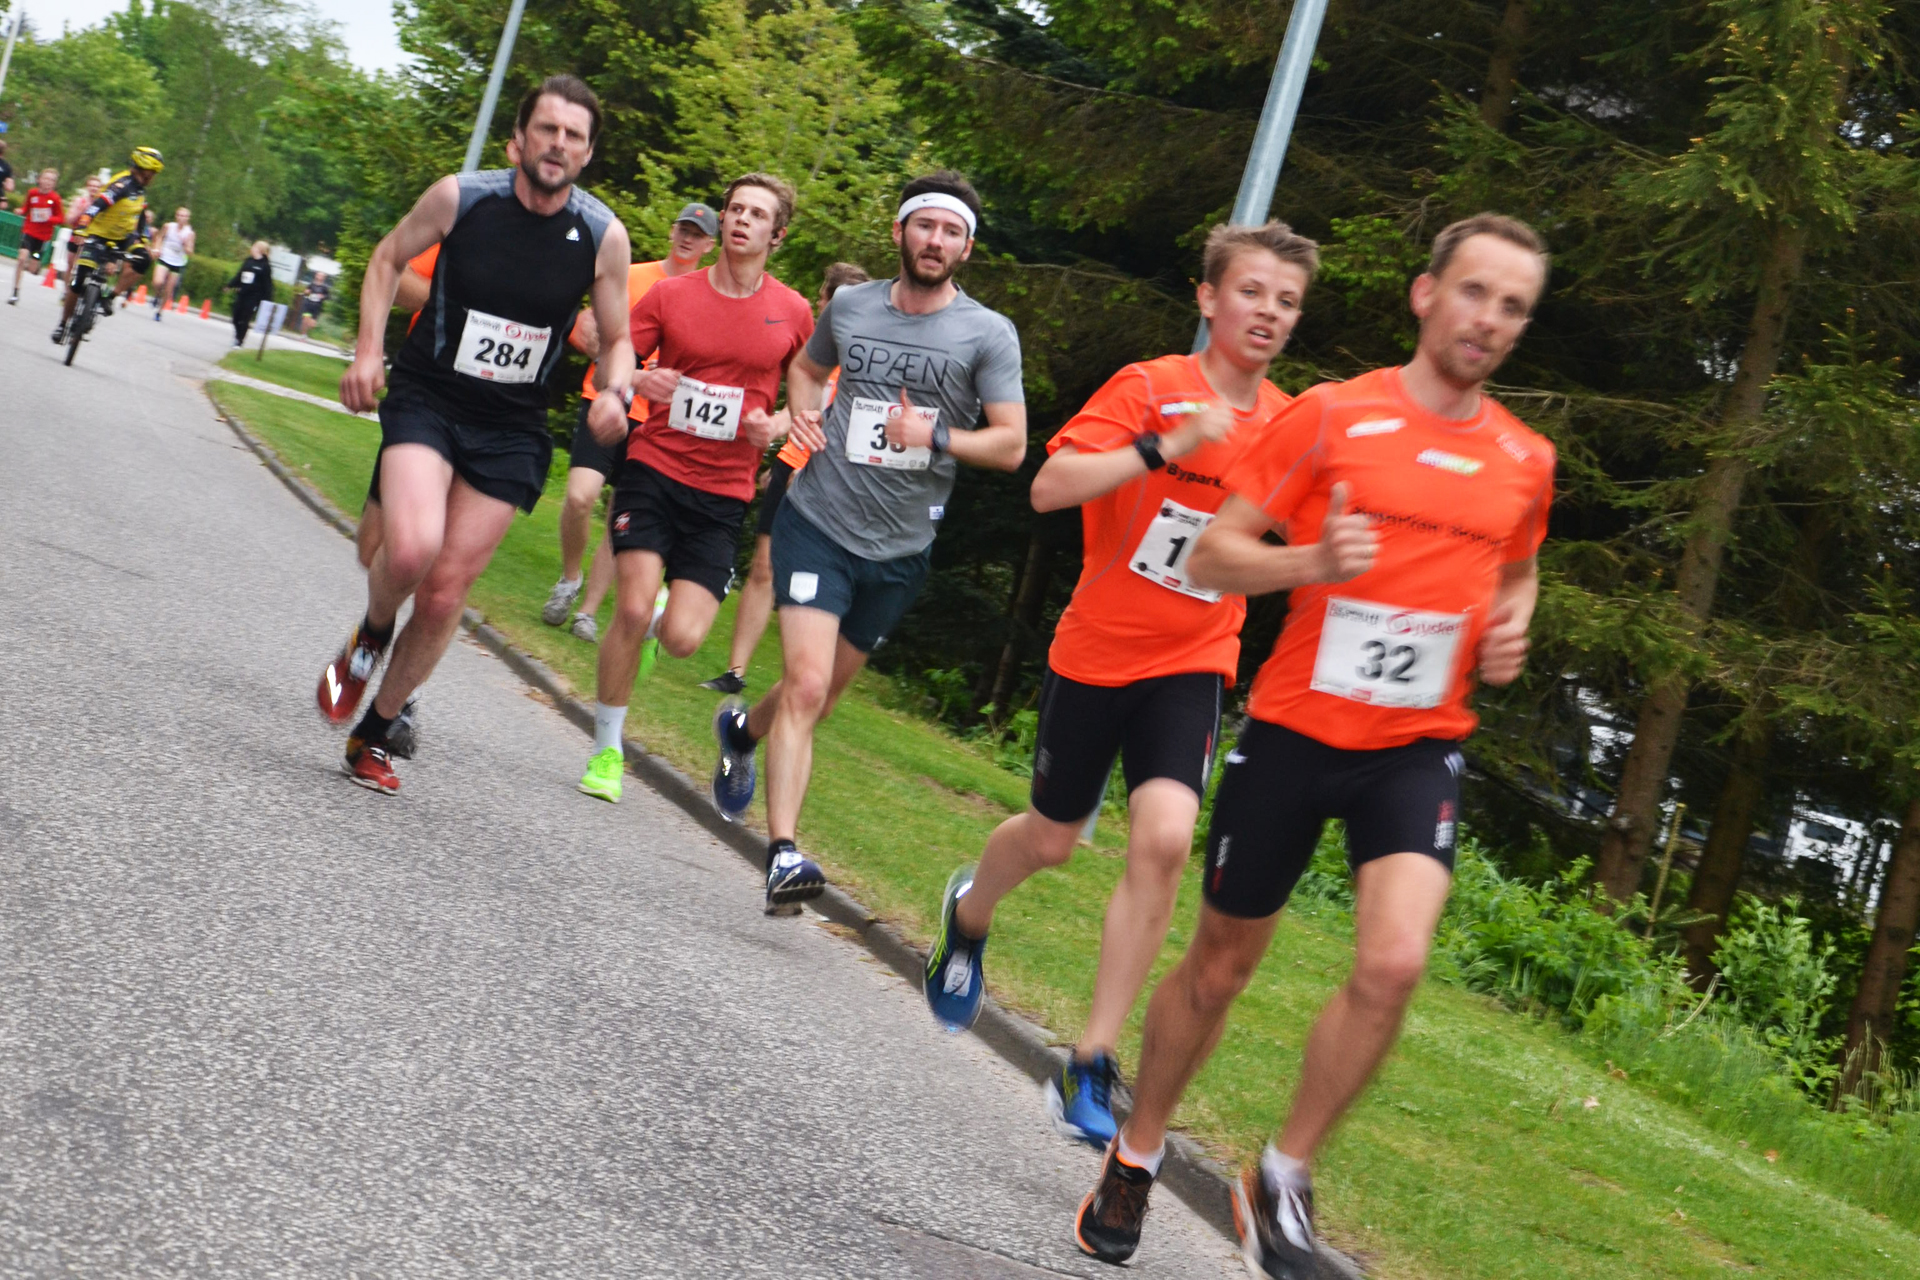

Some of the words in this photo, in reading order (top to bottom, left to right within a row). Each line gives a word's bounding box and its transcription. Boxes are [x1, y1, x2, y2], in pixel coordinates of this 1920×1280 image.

[474, 338, 532, 370] 284
[845, 343, 949, 387] SPÆN
[683, 397, 728, 426] 142
[1354, 640, 1418, 685] 32
